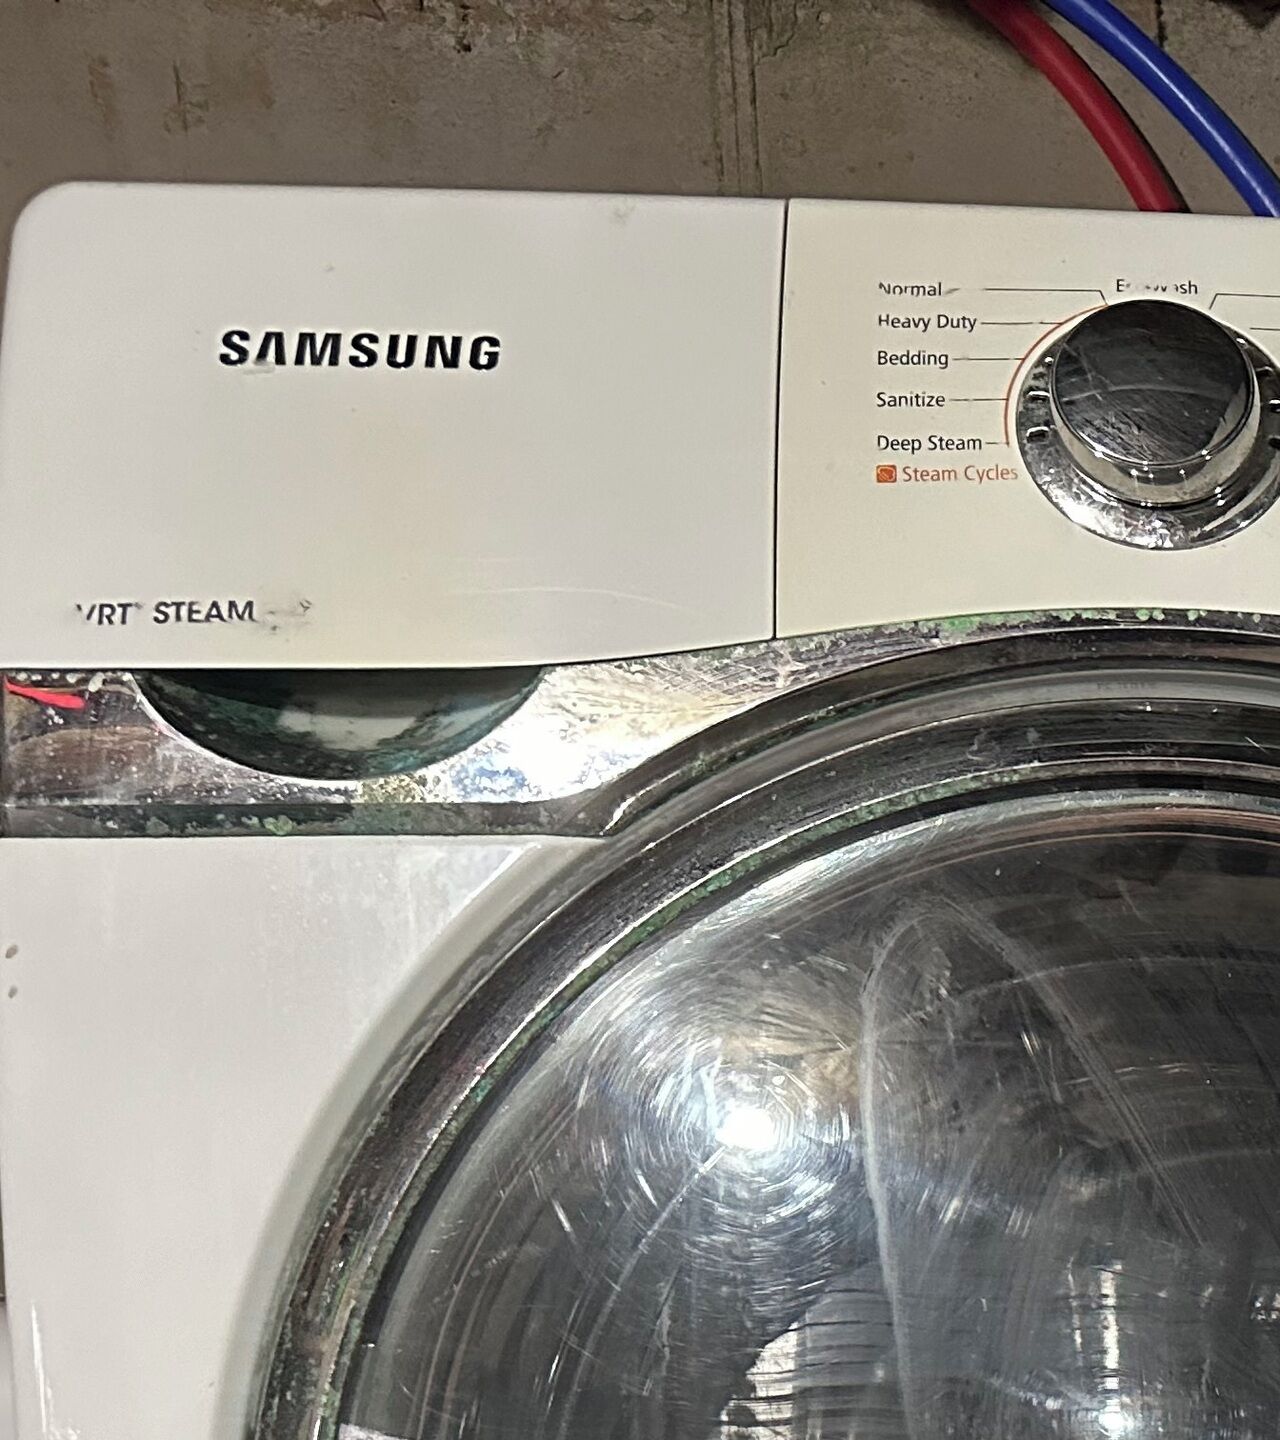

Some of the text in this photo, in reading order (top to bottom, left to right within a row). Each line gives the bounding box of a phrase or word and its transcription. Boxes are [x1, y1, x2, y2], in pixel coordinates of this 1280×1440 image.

[878, 314, 977, 332] Heavy Duty
[219, 331, 500, 371] SAMSUNG
[877, 350, 949, 369] Bedding
[876, 391, 945, 407] Sanitize
[877, 435, 982, 454] Deep Steam
[902, 464, 1019, 484] Steam Cycles
[153, 601, 257, 625] STEAM
